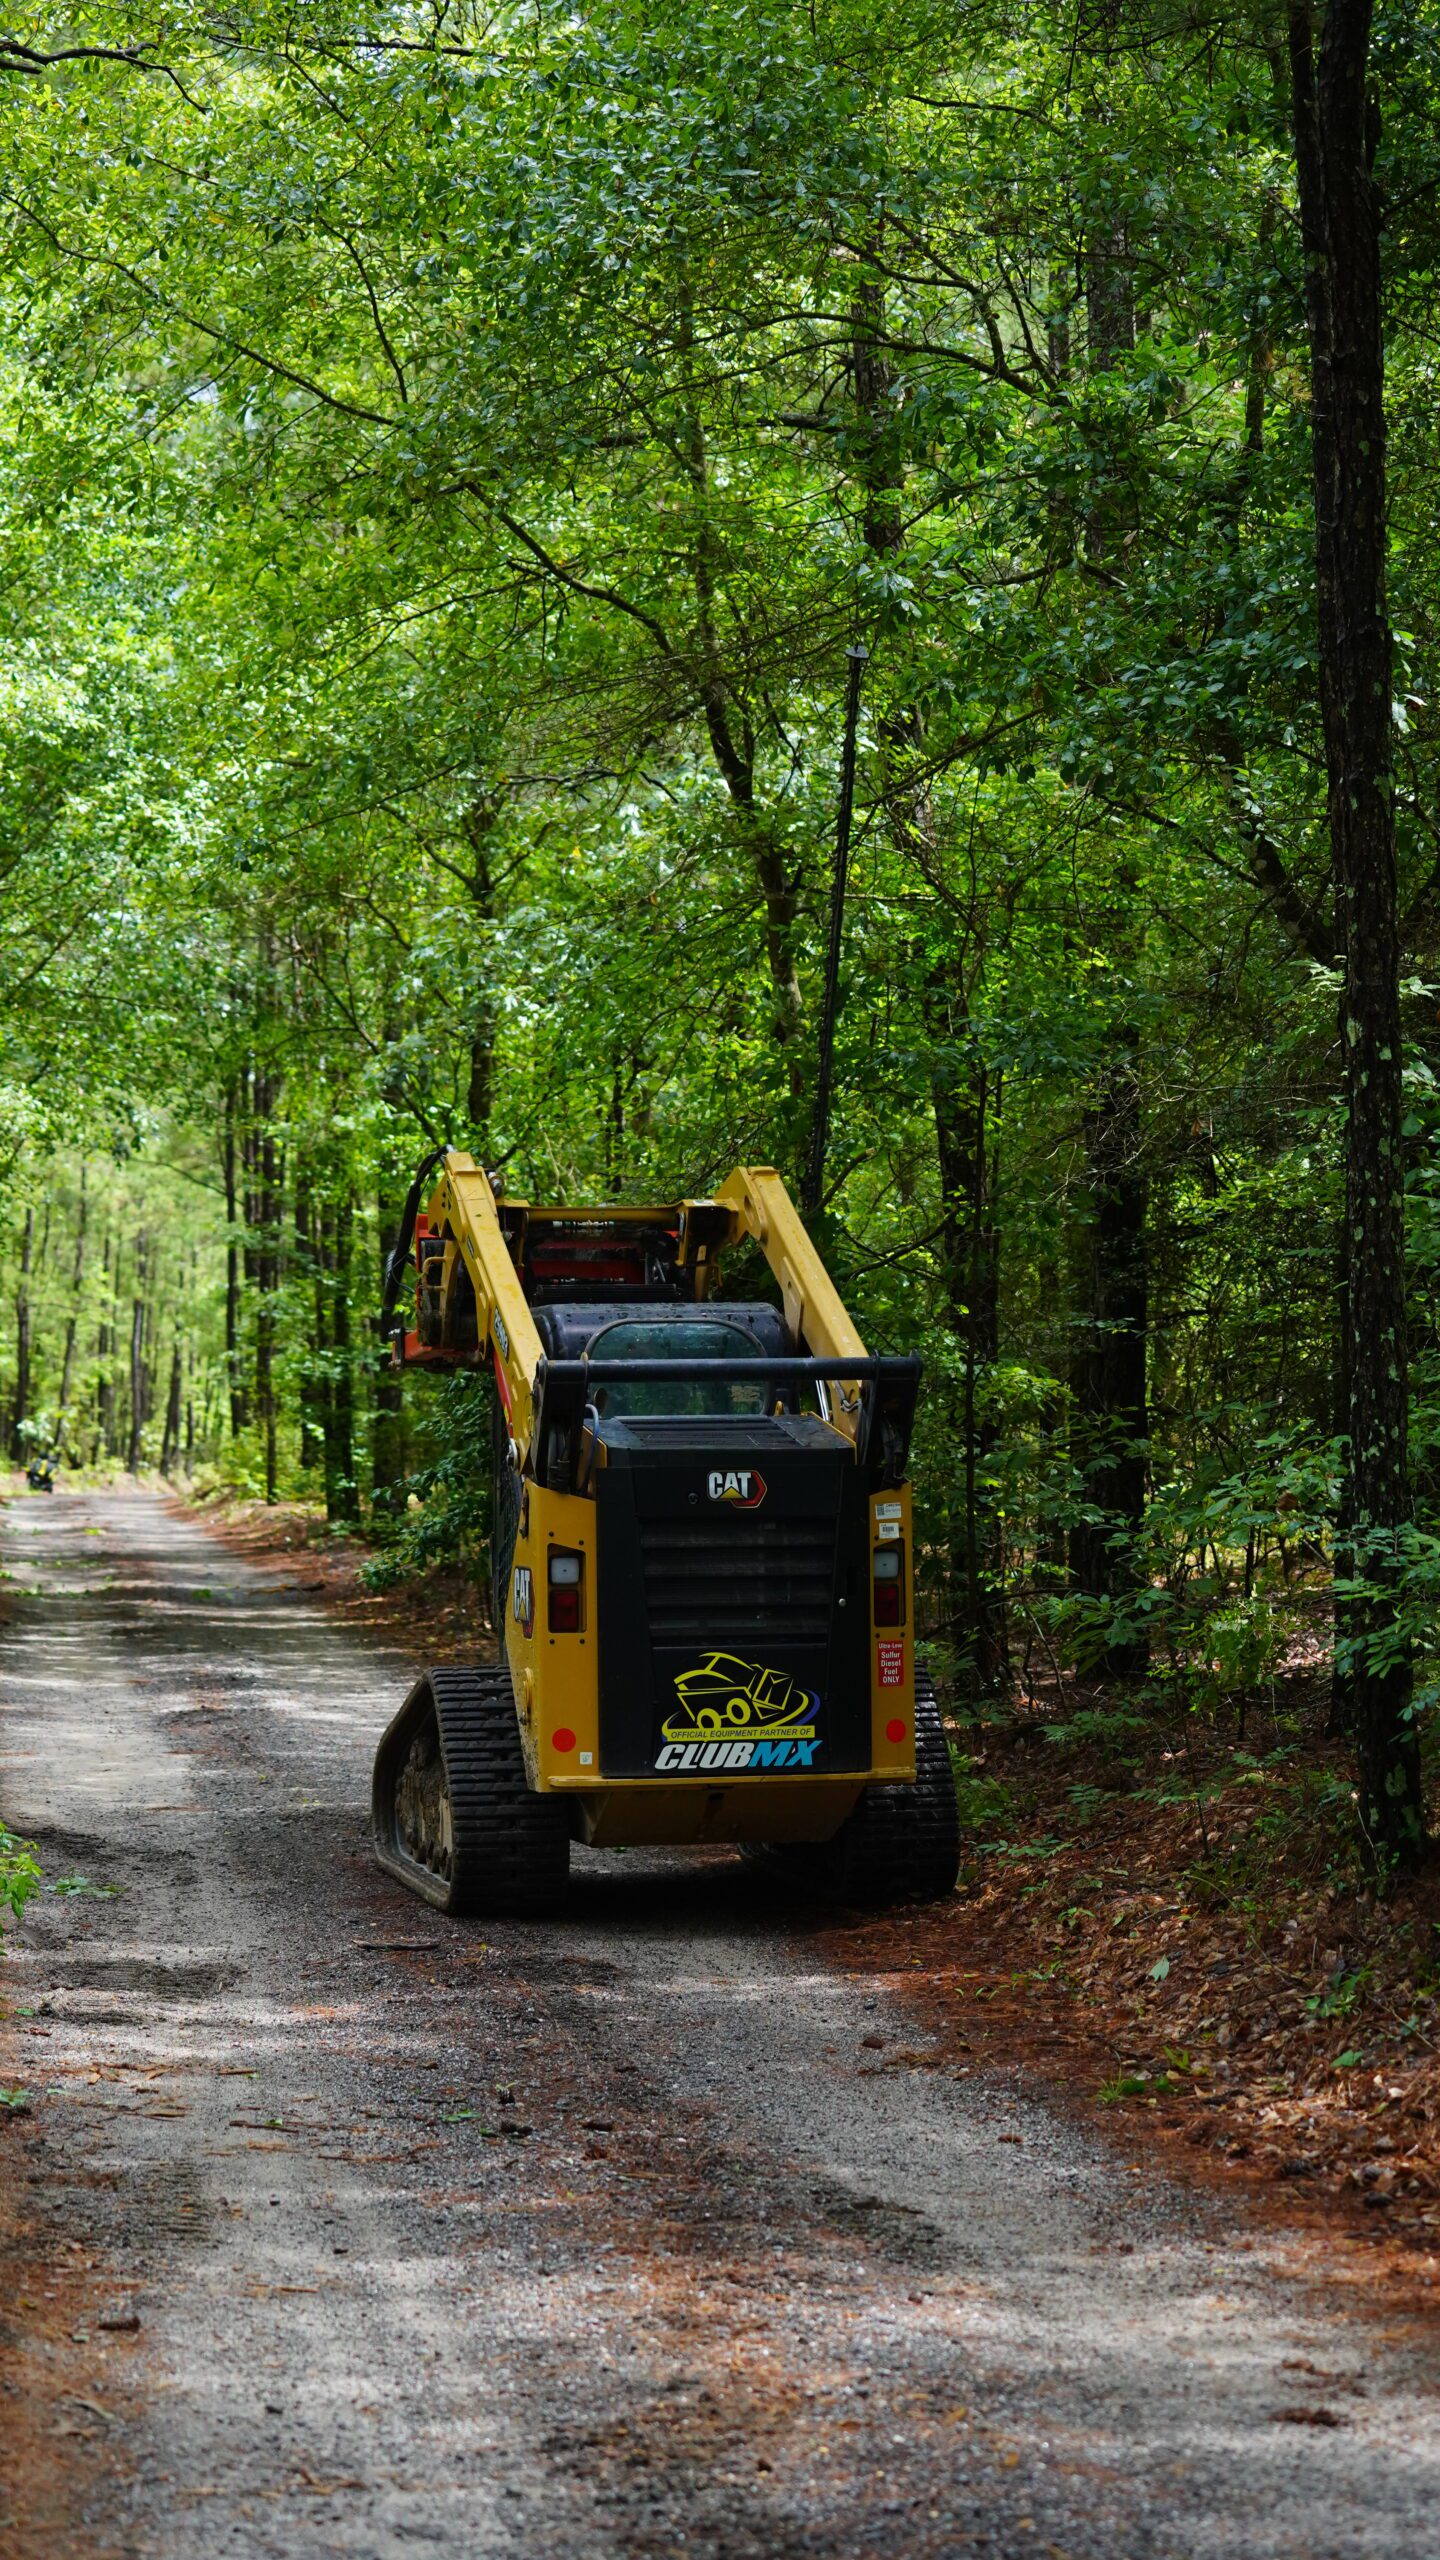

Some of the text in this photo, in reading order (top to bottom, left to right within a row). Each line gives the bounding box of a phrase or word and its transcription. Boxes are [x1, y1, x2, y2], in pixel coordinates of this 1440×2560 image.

[708, 1472, 752, 1499] CAT
[514, 1567, 530, 1620] CAT
[881, 1651, 900, 1659] Sulfur
[880, 1659, 901, 1667] Diesel
[884, 1667, 898, 1675] Fuel
[671, 1727, 812, 1739] OFFICIAL EQUIPMENT PARTNER OF
[654, 1740, 823, 1770] CLUBMX
